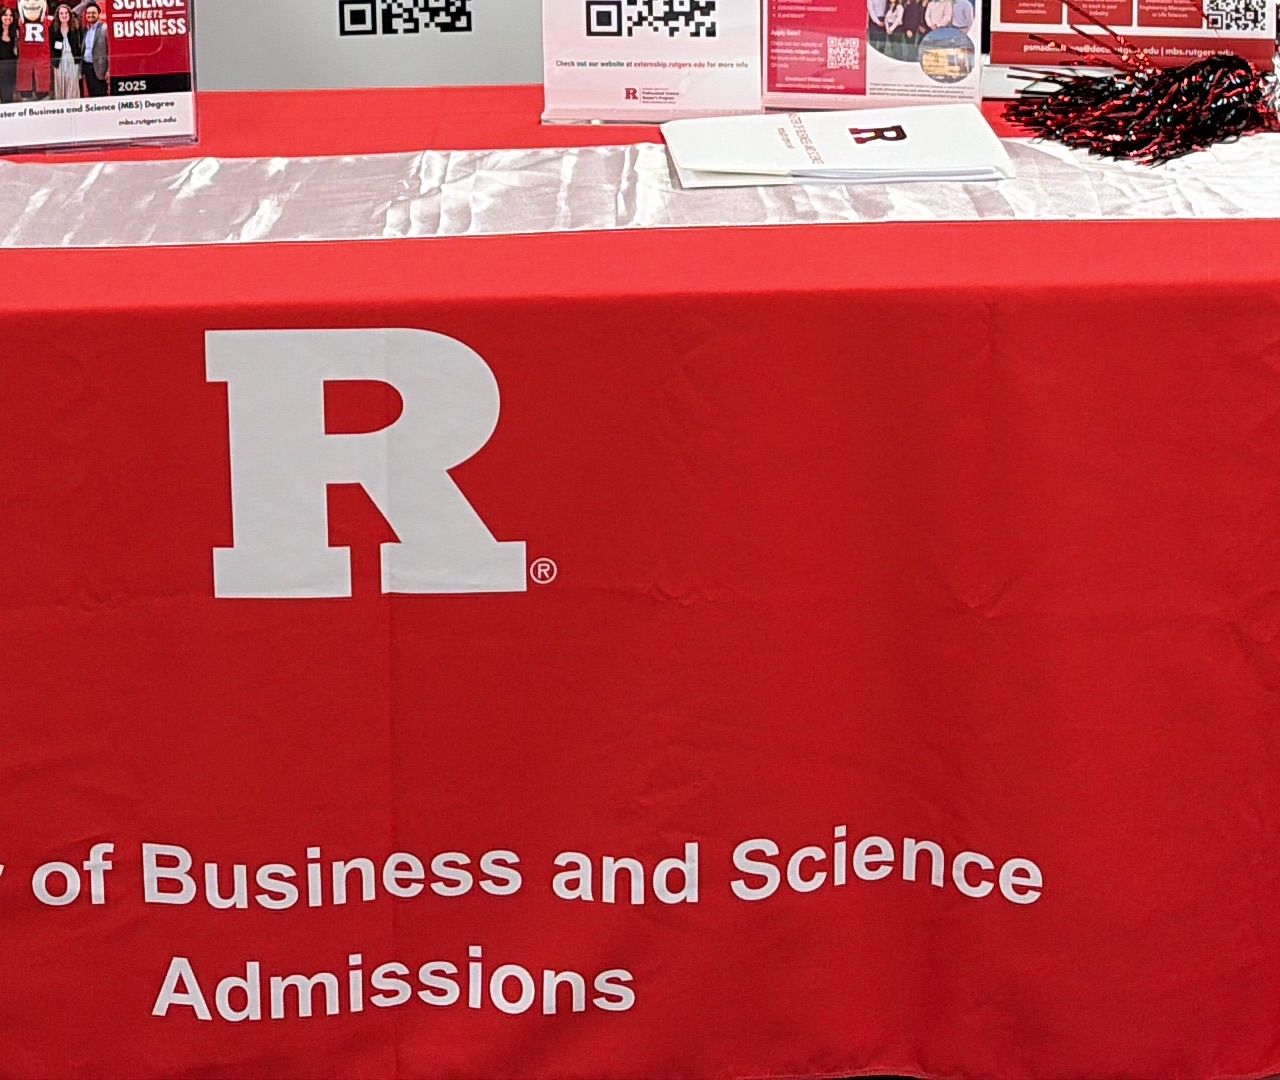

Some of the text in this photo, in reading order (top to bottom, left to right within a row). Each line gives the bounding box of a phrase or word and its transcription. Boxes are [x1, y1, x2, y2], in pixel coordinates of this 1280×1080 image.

[134, 9, 163, 20] MEETS
[113, 18, 187, 38] BUSINESS
[117, 80, 147, 92] 2025
[18, 108, 27, 117] of
[29, 107, 64, 117] Business
[66, 104, 83, 113] and
[85, 102, 116, 112] Science
[118, 101, 142, 111] (MBS)
[145, 100, 175, 109] Degree
[118, 117, 177, 126] mbs.rutgers.edu
[848, 124, 908, 145] R
[205, 327, 527, 598] R
[31, 841, 116, 908] of
[140, 840, 523, 912] Business
[551, 840, 703, 906] and
[729, 825, 1046, 909] Science
[150, 944, 638, 1025] Admissions
